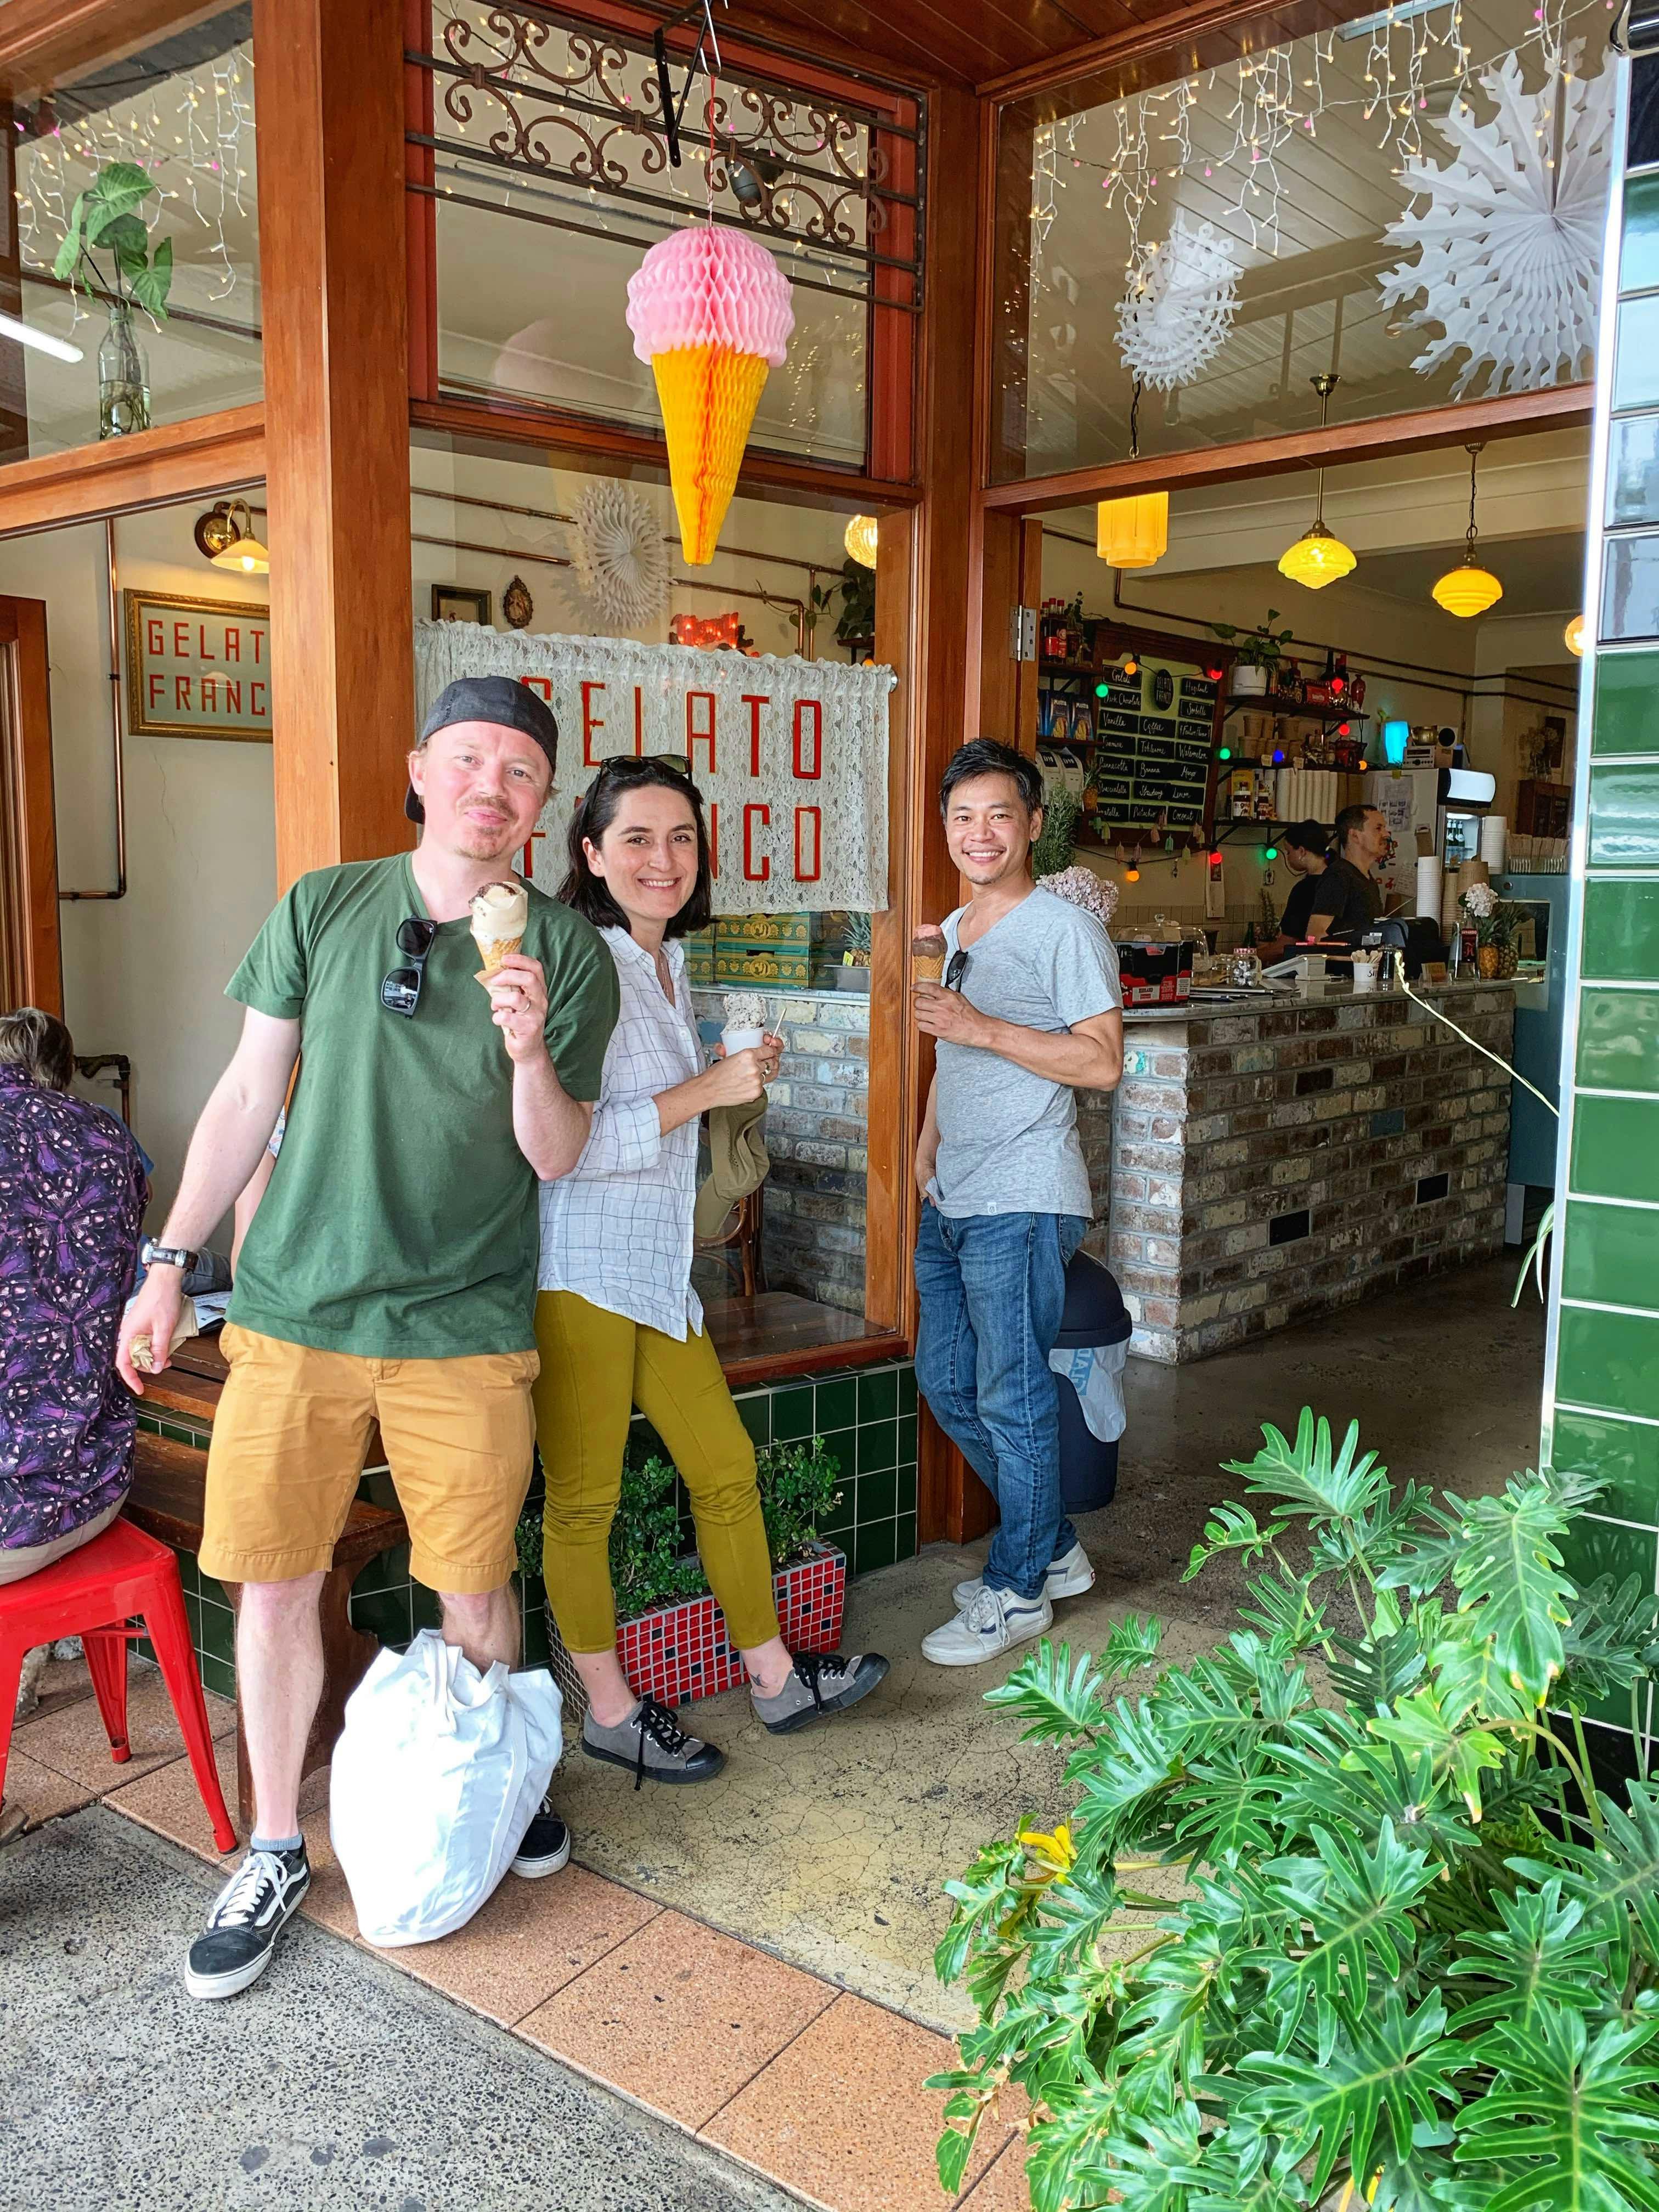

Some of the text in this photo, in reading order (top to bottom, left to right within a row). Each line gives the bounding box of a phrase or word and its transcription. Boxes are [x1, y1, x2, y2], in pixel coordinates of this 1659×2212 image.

[1119, 693, 1141, 706] Chocolate
[1103, 711, 1126, 727] Vanilla
[1143, 719, 1164, 734] Coffee
[1179, 744, 1207, 759] Watermelon
[1141, 762, 1160, 777] Banana
[1181, 765, 1197, 781] Mango
[1172, 787, 1191, 798] Lemon
[1133, 806, 1157, 818] Pistachio
[1172, 809, 1194, 821] Coconut
